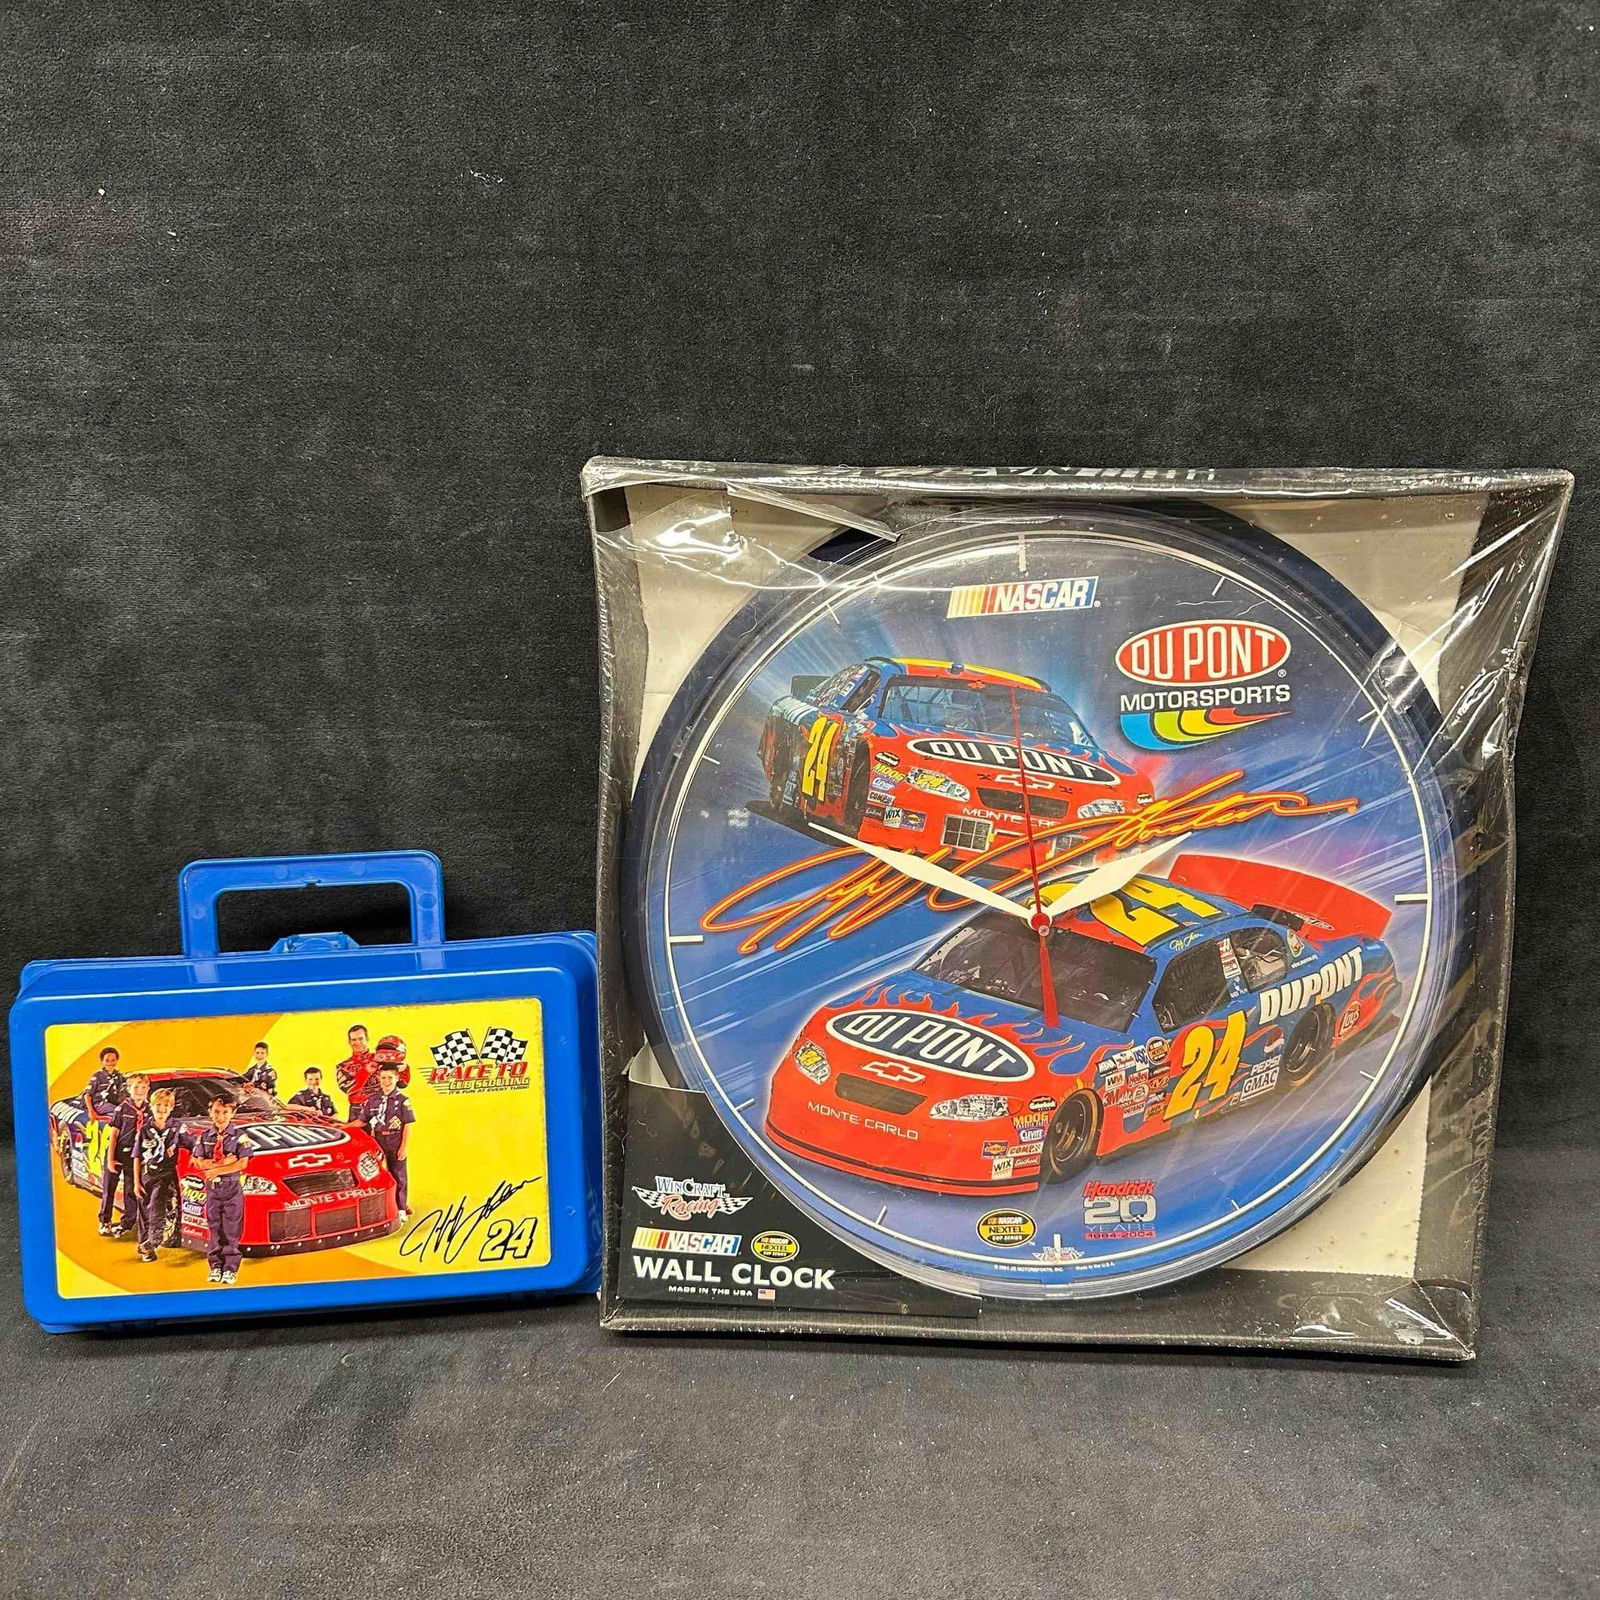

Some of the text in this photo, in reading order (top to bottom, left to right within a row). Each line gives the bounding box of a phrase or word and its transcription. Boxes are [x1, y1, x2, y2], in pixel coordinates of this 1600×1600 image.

[994, 580, 1088, 610] NASCAR
[1131, 625, 1277, 681] DU PONT
[1119, 684, 1291, 712] MOTORSPORTS
[801, 716, 840, 801] 24
[928, 741, 984, 761] DU
[986, 744, 1097, 778] PONT
[885, 809, 901, 820] WIX
[1258, 946, 1363, 1026] DUPONT
[843, 1013, 1018, 1074] DU PONT
[428, 1061, 529, 1083] RACE TO
[1163, 1009, 1247, 1122] 24
[1243, 1067, 1279, 1094] GMAC
[808, 1101, 919, 1141] MONTE CARLO
[1013, 1111, 1049, 1126] MOOG
[993, 1158, 1012, 1172] WIX
[283, 1187, 378, 1209] MONTE CARLO
[1083, 1179, 1156, 1201] Hendrick
[660, 1194, 722, 1221] Racing
[1083, 1194, 1157, 1225] 20
[478, 1217, 539, 1263] 24
[988, 1225, 1024, 1234] NEXTEL
[1085, 1223, 1155, 1232] YEARS
[666, 1232, 737, 1255] NASCAR
[632, 1255, 836, 1291] WALL CLOCK
[668, 1285, 697, 1293] MADE
[733, 1289, 753, 1297] USA
